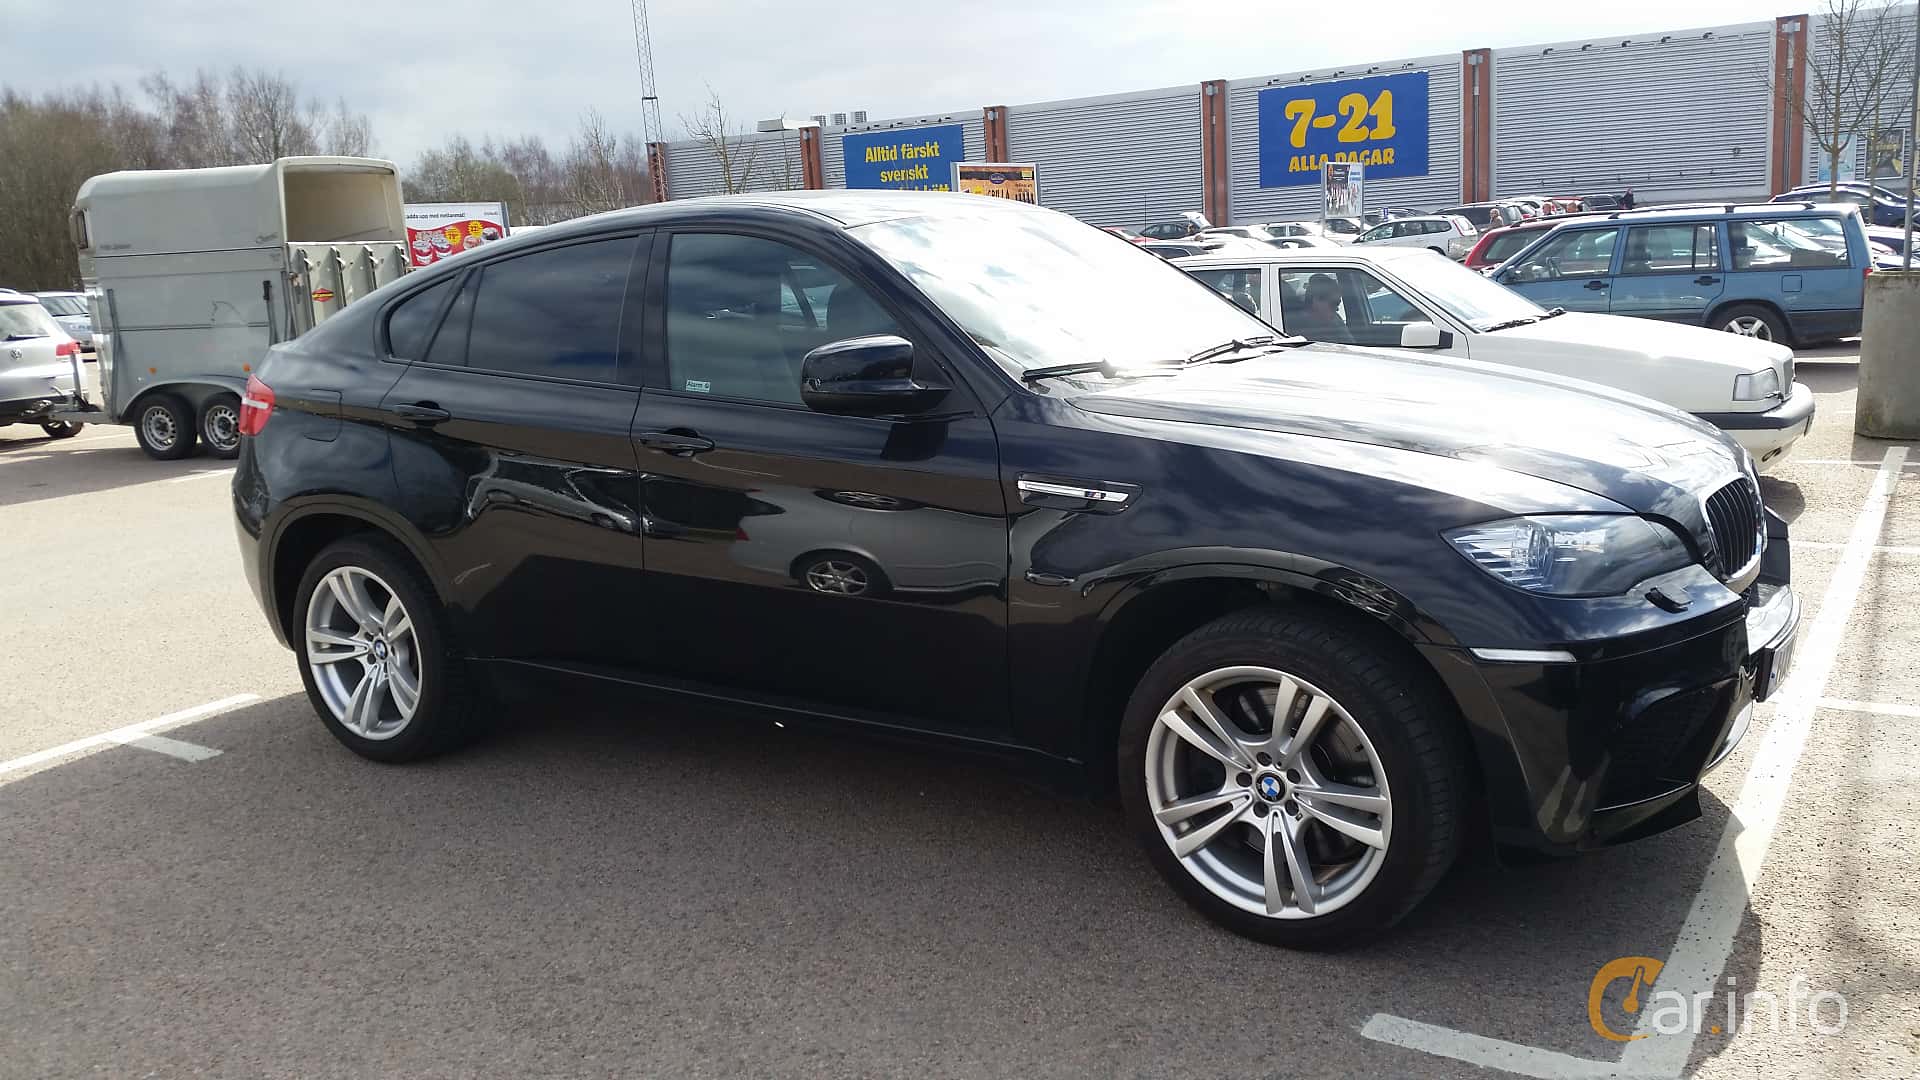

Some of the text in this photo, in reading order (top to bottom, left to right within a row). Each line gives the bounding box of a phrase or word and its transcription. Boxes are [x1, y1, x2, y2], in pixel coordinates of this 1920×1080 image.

[1284, 89, 1396, 148] 7-21
[865, 141, 940, 162] Alltid färskt
[880, 165, 928, 182] svenskt
[1288, 154, 1328, 173] ALLA
